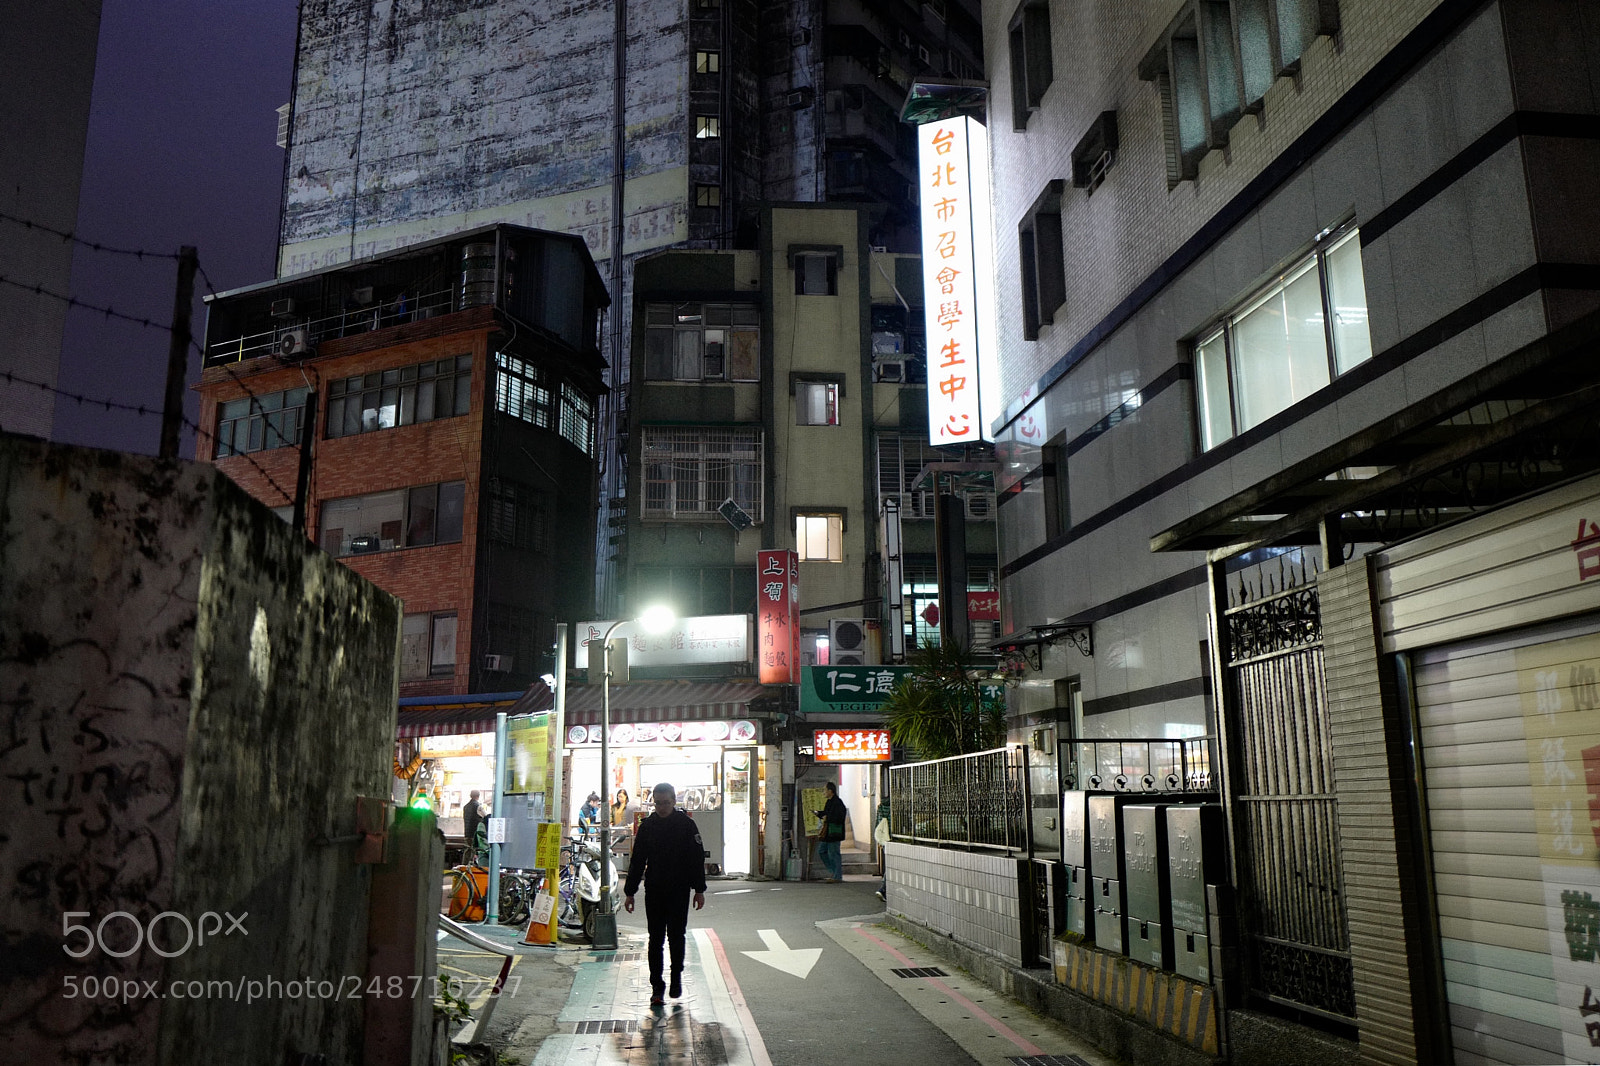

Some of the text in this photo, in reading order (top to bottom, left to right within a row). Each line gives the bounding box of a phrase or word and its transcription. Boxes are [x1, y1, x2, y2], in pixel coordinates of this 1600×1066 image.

[931, 128, 970, 438] 台北市召會學生中心
[762, 556, 785, 602] 上賀
[828, 702, 883, 711] VEGET
